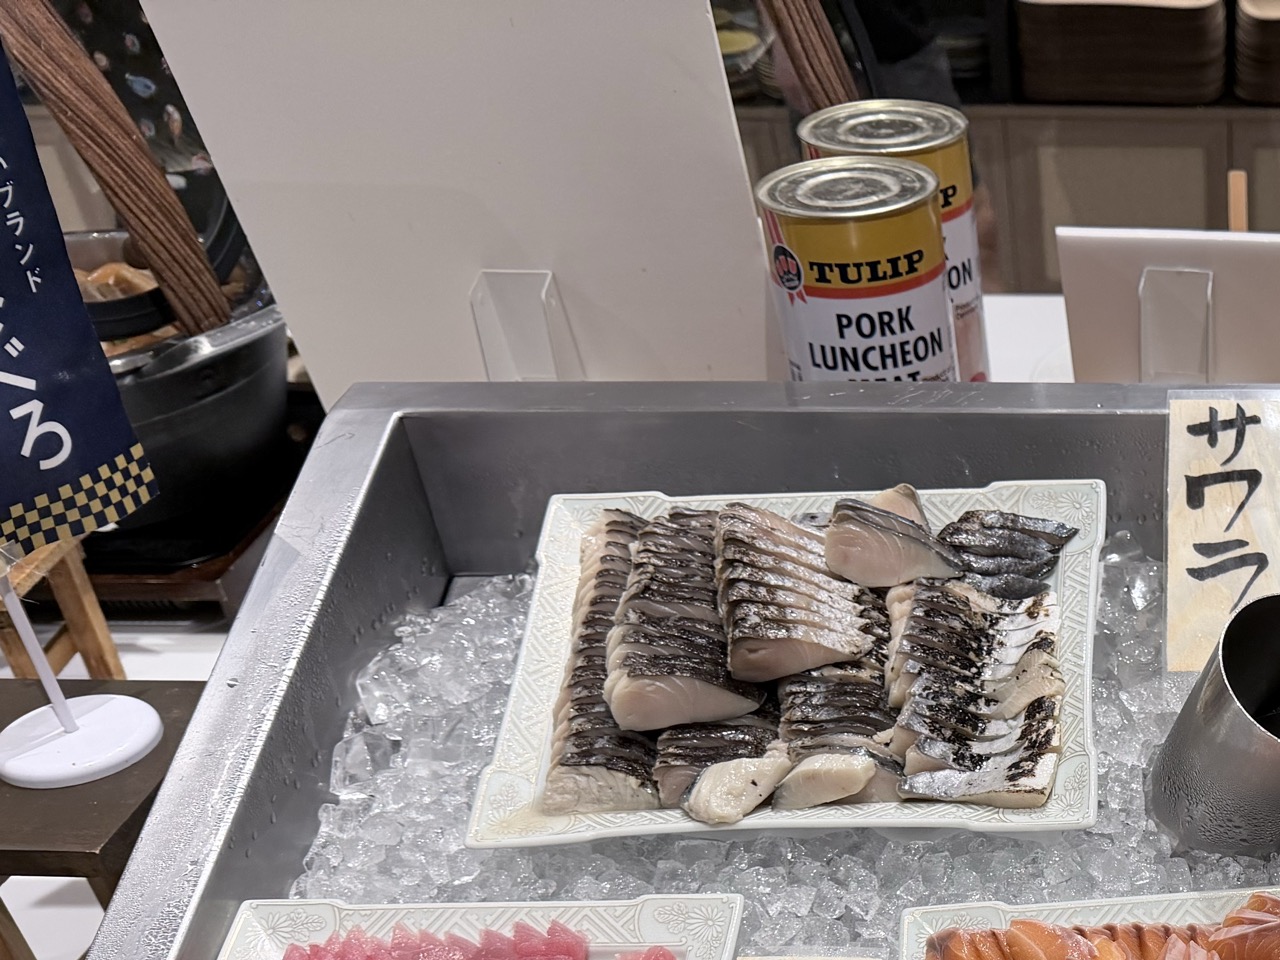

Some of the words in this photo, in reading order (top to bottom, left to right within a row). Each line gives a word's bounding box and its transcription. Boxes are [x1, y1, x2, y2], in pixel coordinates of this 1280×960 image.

[0, 157, 42, 293] ブランド
[809, 250, 924, 284] TULIP
[836, 306, 915, 339] PORK
[809, 328, 944, 372] LUNCHEON
[1184, 403, 1269, 614] サワラ
